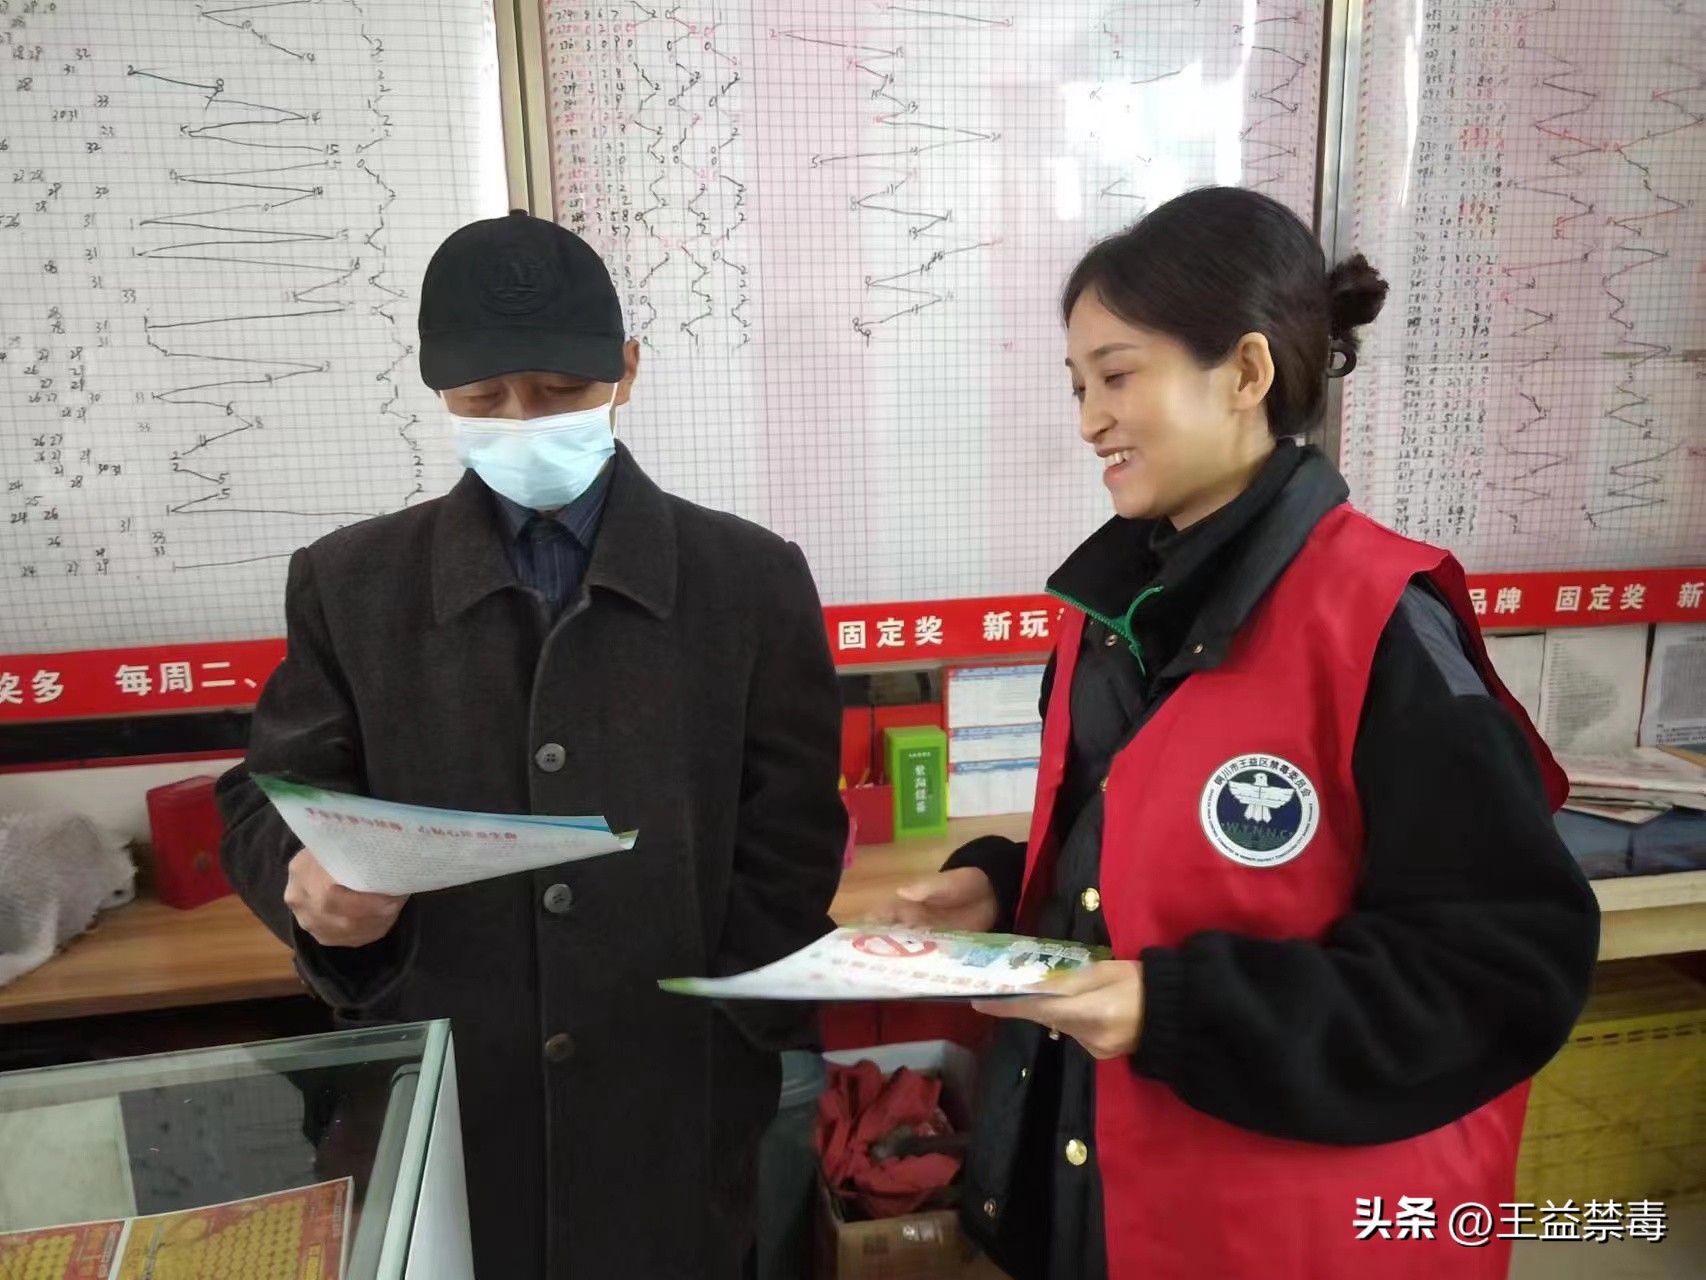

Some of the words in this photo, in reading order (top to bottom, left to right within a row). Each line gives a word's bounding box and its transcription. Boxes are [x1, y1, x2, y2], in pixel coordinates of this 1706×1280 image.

[1468, 585, 1522, 616] 品牌
[1555, 583, 1645, 613] 固定奖
[838, 615, 943, 650] 固定奖
[983, 609, 1049, 641] 新玩
[1214, 756, 1312, 798] 铜川市王益区禁毒委员会
